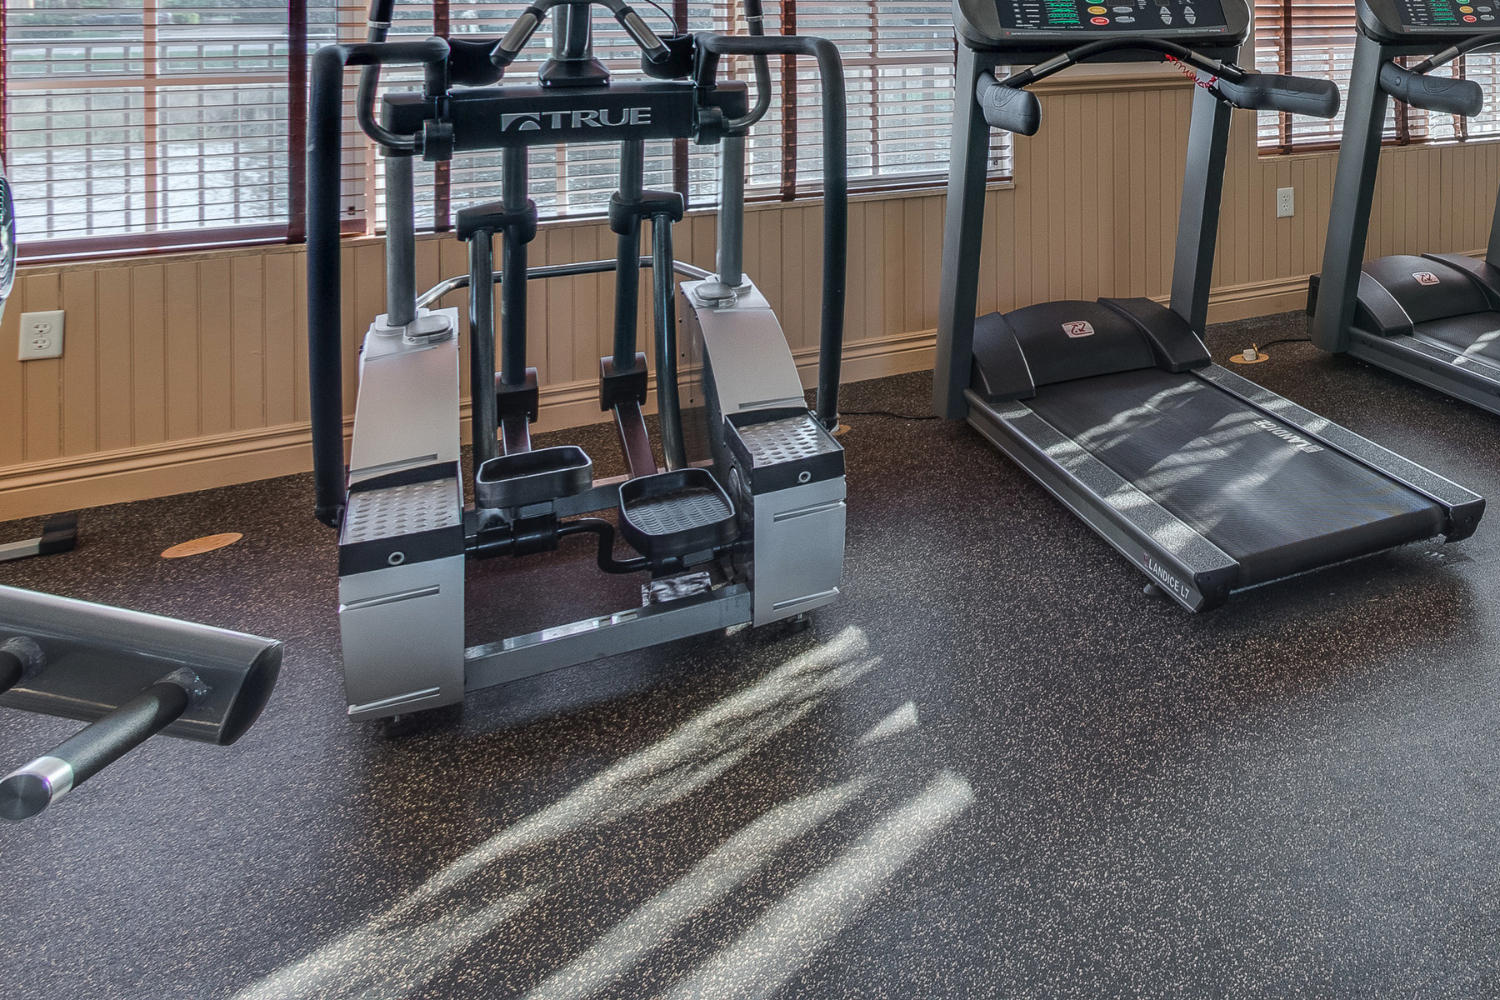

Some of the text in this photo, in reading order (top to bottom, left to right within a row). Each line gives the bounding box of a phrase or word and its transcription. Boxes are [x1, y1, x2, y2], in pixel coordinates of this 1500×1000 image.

[541, 107, 651, 129] TRUE
[1149, 558, 1190, 600] LANDICE L7
